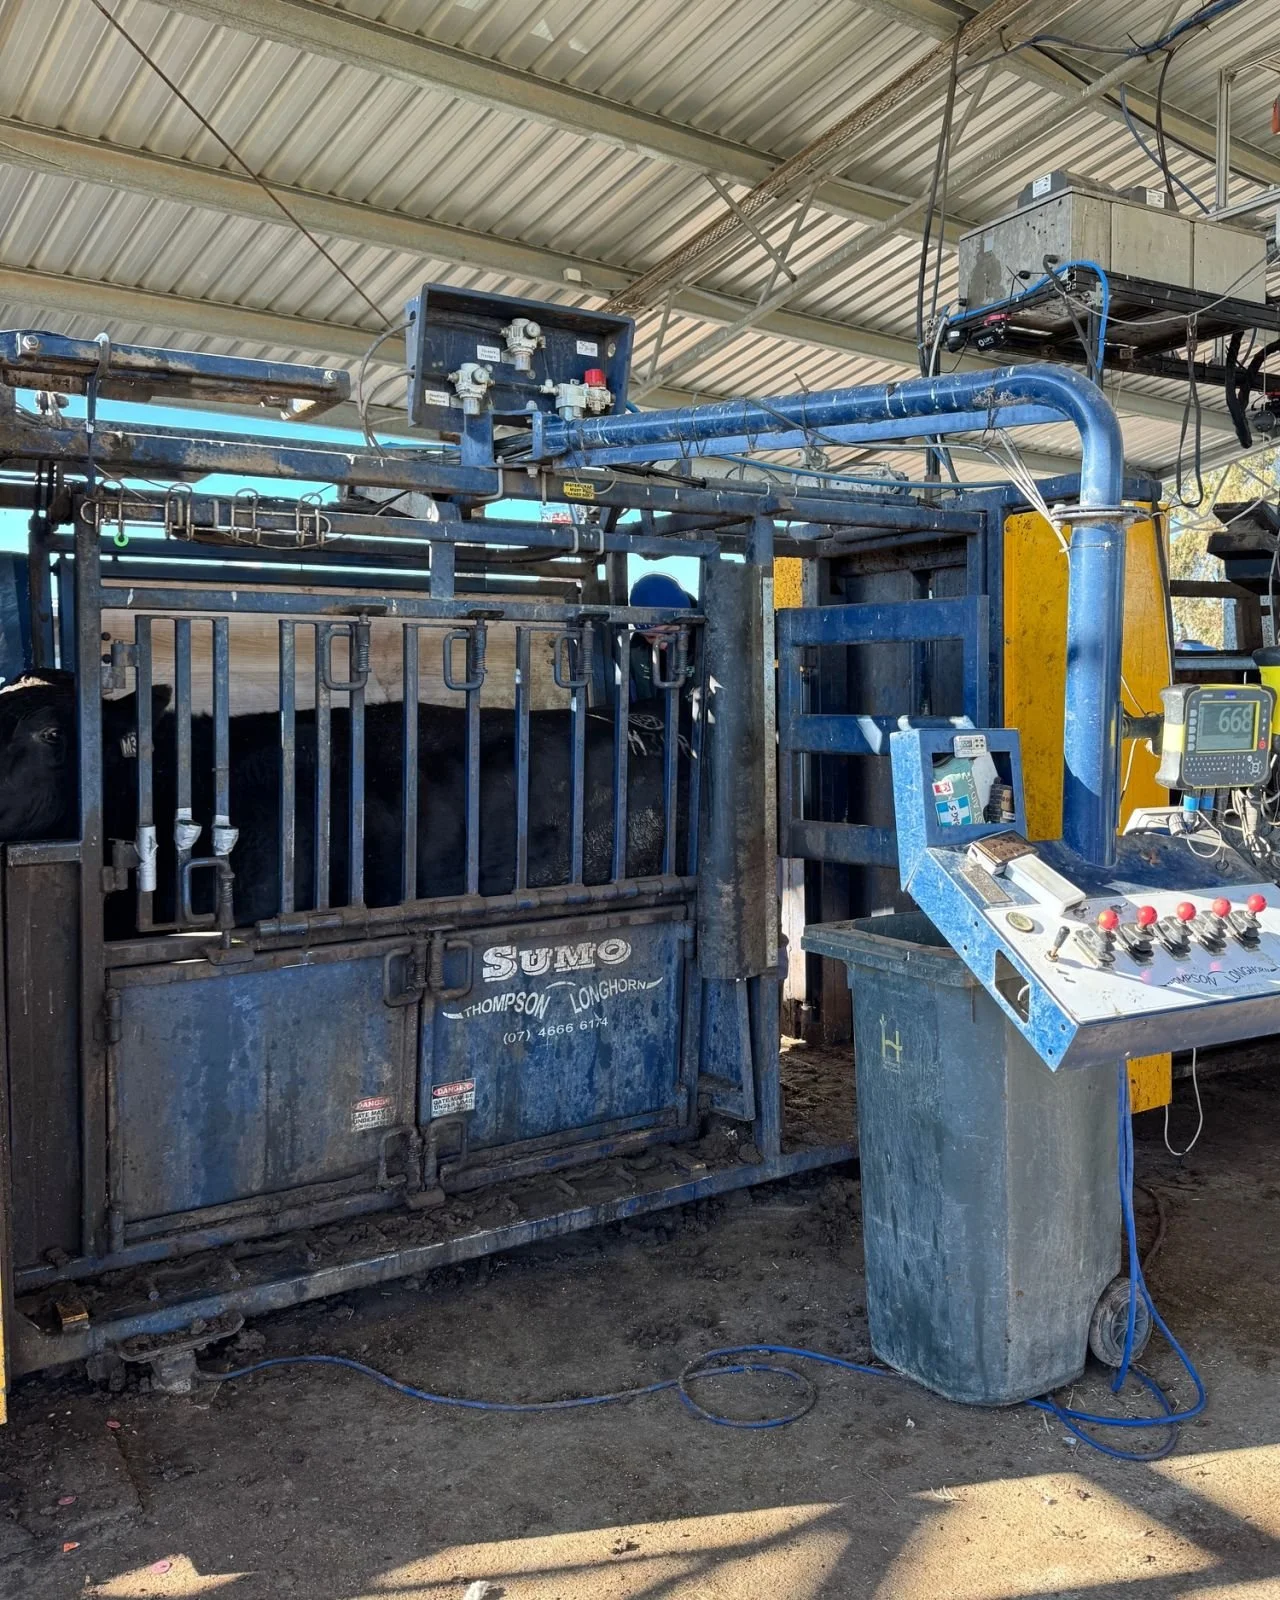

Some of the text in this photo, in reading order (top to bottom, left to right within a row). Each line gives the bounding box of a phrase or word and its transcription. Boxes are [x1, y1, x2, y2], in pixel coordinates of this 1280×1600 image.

[1218, 707, 1253, 733] 668
[482, 938, 632, 983] SUMO
[1224, 966, 1270, 984] LONGHORN
[463, 978, 647, 1020] THOMPSON LONGHORN
[503, 1017, 609, 1045] (07) 4666 6174
